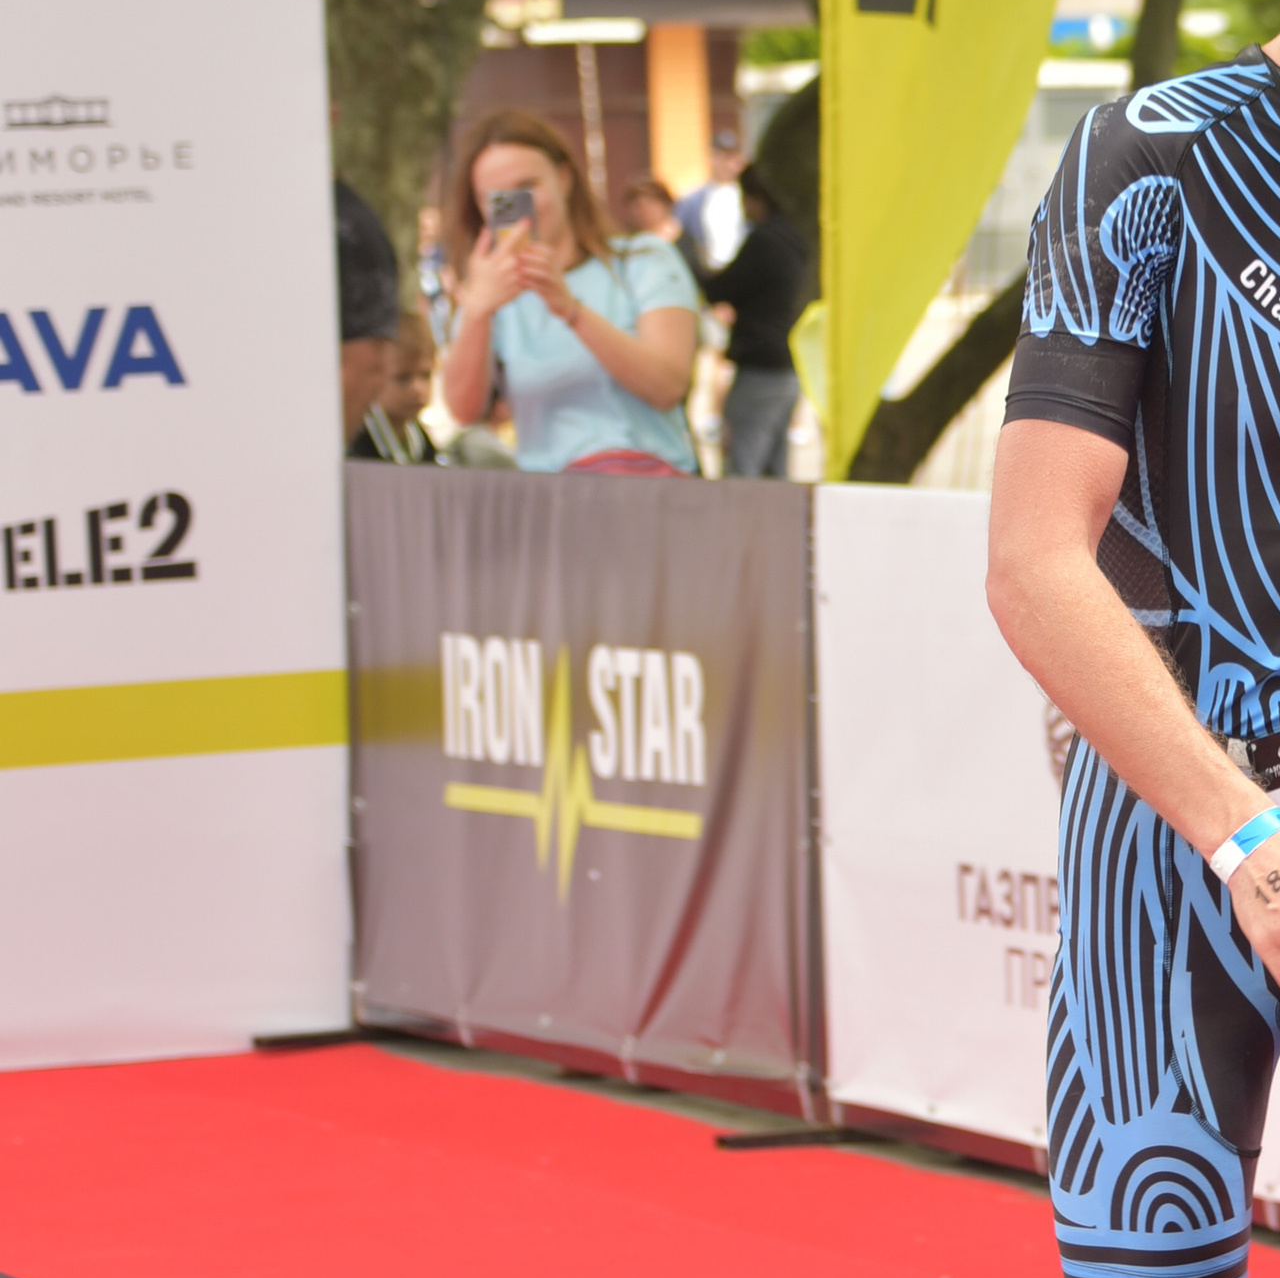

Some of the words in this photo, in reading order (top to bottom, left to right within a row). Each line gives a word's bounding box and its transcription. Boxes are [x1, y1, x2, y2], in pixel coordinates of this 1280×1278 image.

[4, 491, 197, 590] ELE2
[441, 631, 545, 767] IRON
[588, 643, 706, 787] STAR
